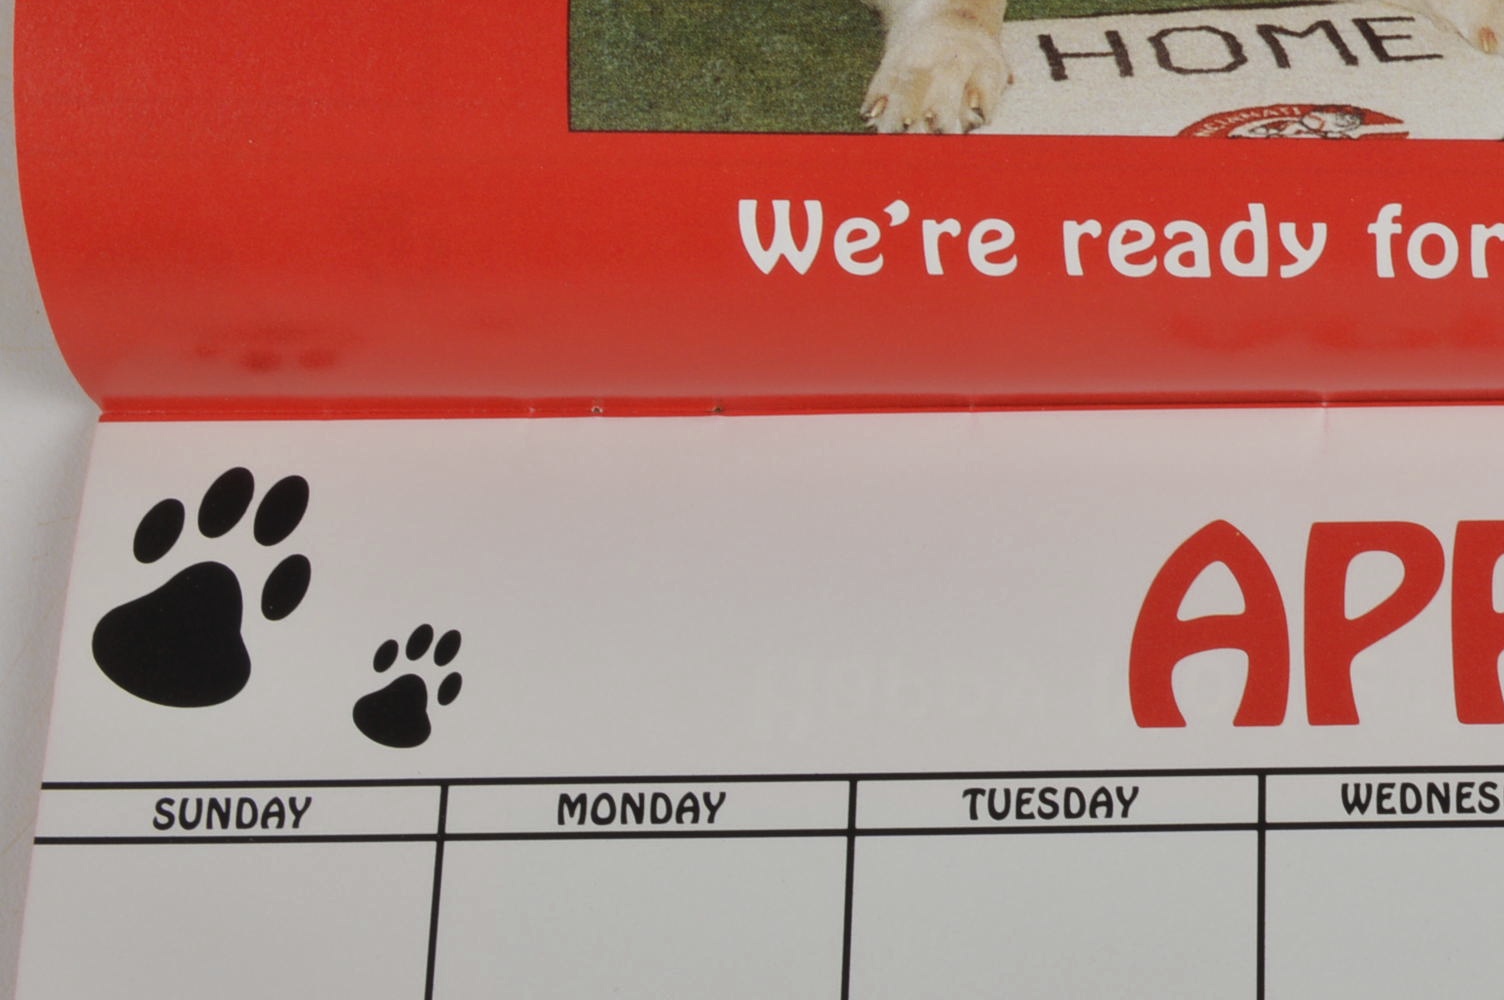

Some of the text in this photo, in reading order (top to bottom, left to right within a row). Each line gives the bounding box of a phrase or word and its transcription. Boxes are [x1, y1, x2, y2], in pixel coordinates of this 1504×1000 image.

[1038, 16, 1443, 81] HOME
[738, 198, 1018, 277] We're
[1062, 202, 1328, 279] ready
[152, 796, 312, 831] SUNDAY
[557, 791, 727, 826] MONDAY
[962, 786, 1139, 821] TUESDAY
